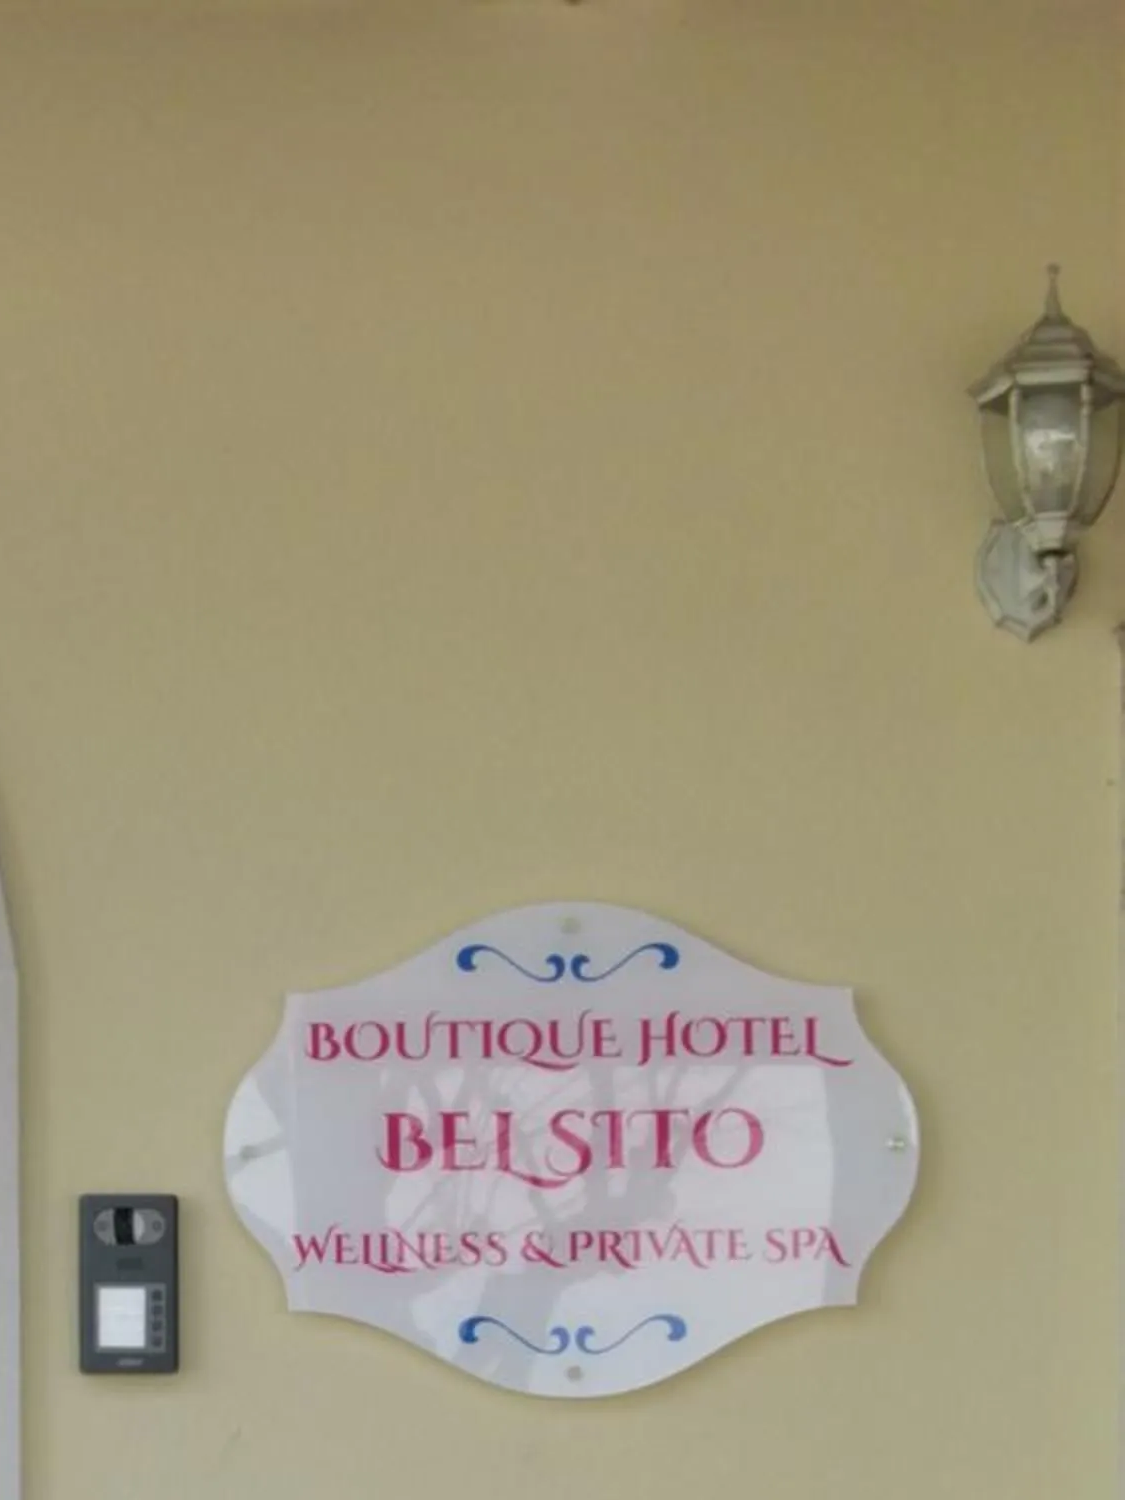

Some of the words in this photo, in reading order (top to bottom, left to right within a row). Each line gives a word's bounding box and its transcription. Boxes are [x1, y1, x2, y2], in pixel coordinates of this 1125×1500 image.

[305, 1010, 622, 1071] BOUTIQUE
[637, 1011, 855, 1067] HOTEL
[377, 1107, 765, 1189] BELSITO
[293, 1222, 507, 1274] WELLNESS
[519, 1231, 567, 1269] &
[568, 1219, 752, 1270] PRIVATE
[765, 1226, 851, 1268] SPA
